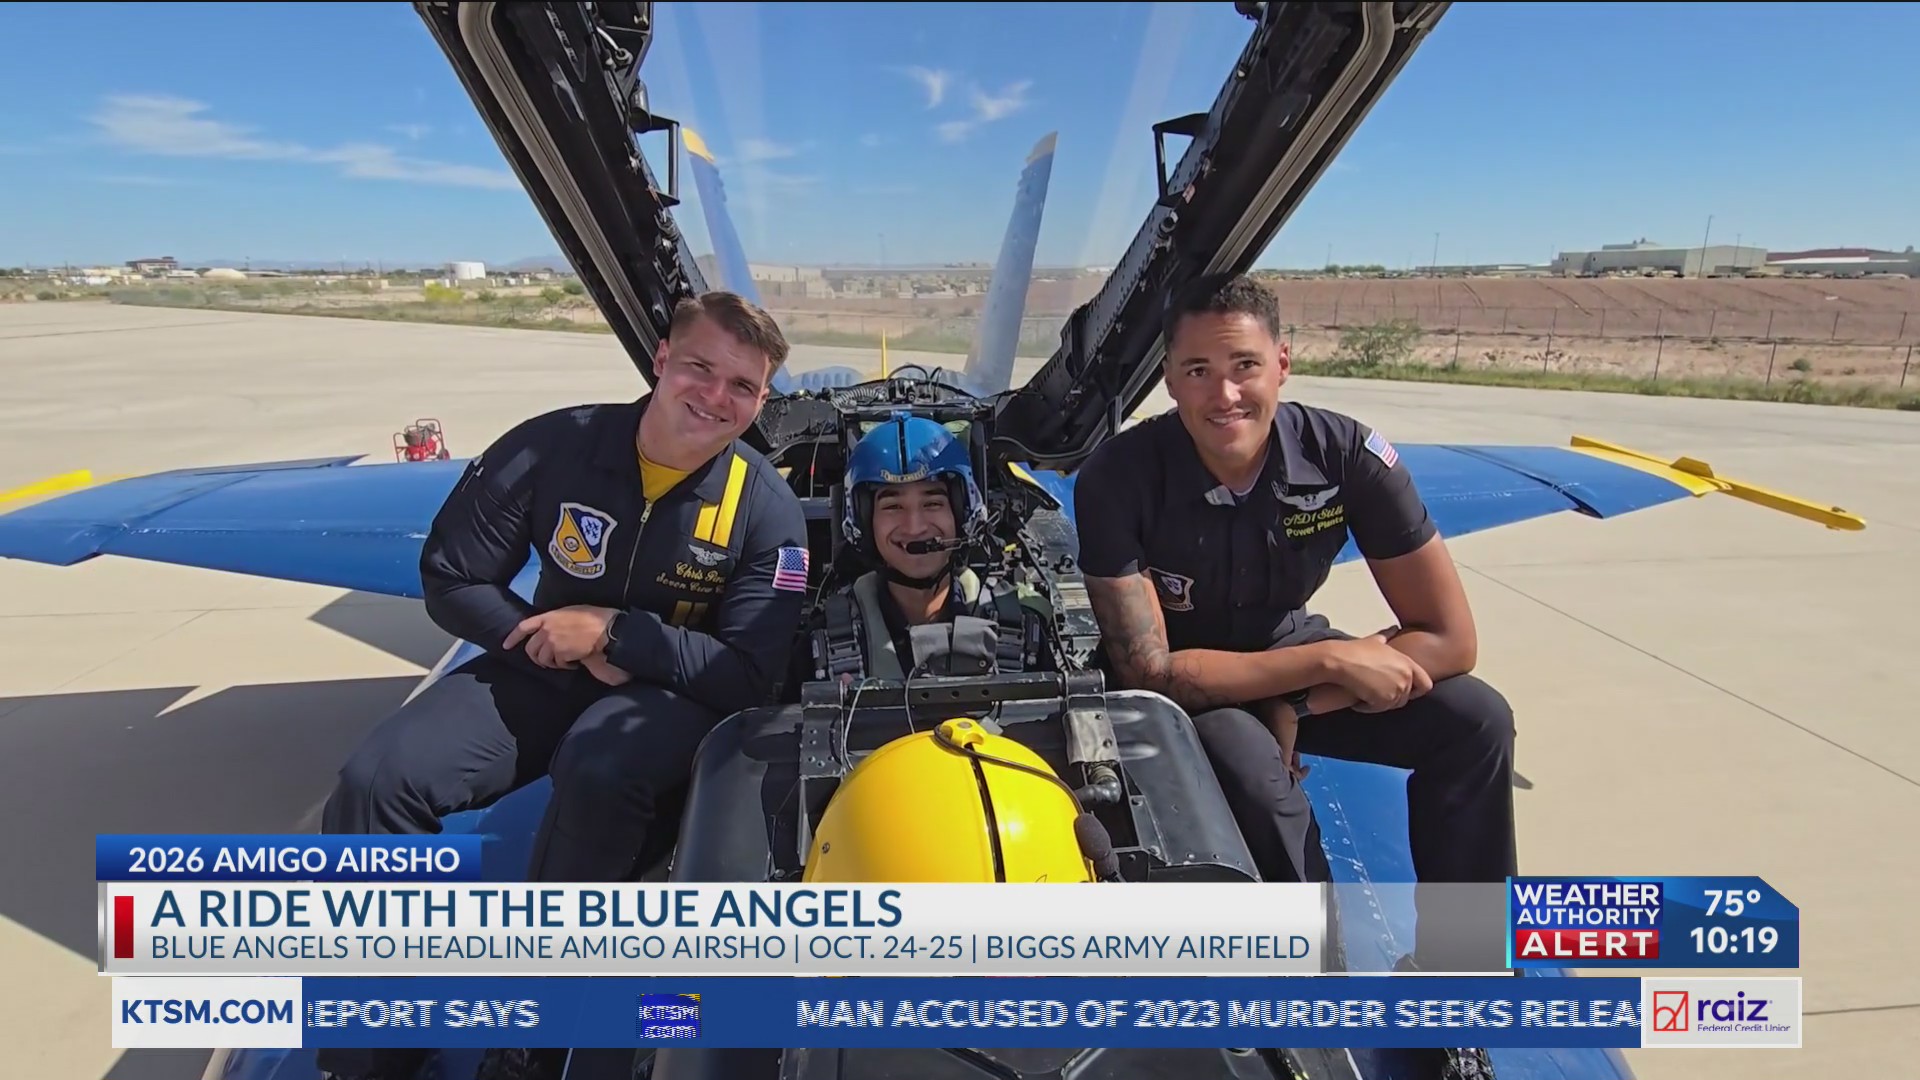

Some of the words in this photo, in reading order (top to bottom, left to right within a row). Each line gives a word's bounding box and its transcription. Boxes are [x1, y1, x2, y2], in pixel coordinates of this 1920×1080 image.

[1286, 526, 1315, 538] Power
[1317, 516, 1344, 531] Plants
[675, 561, 703, 580] Chris
